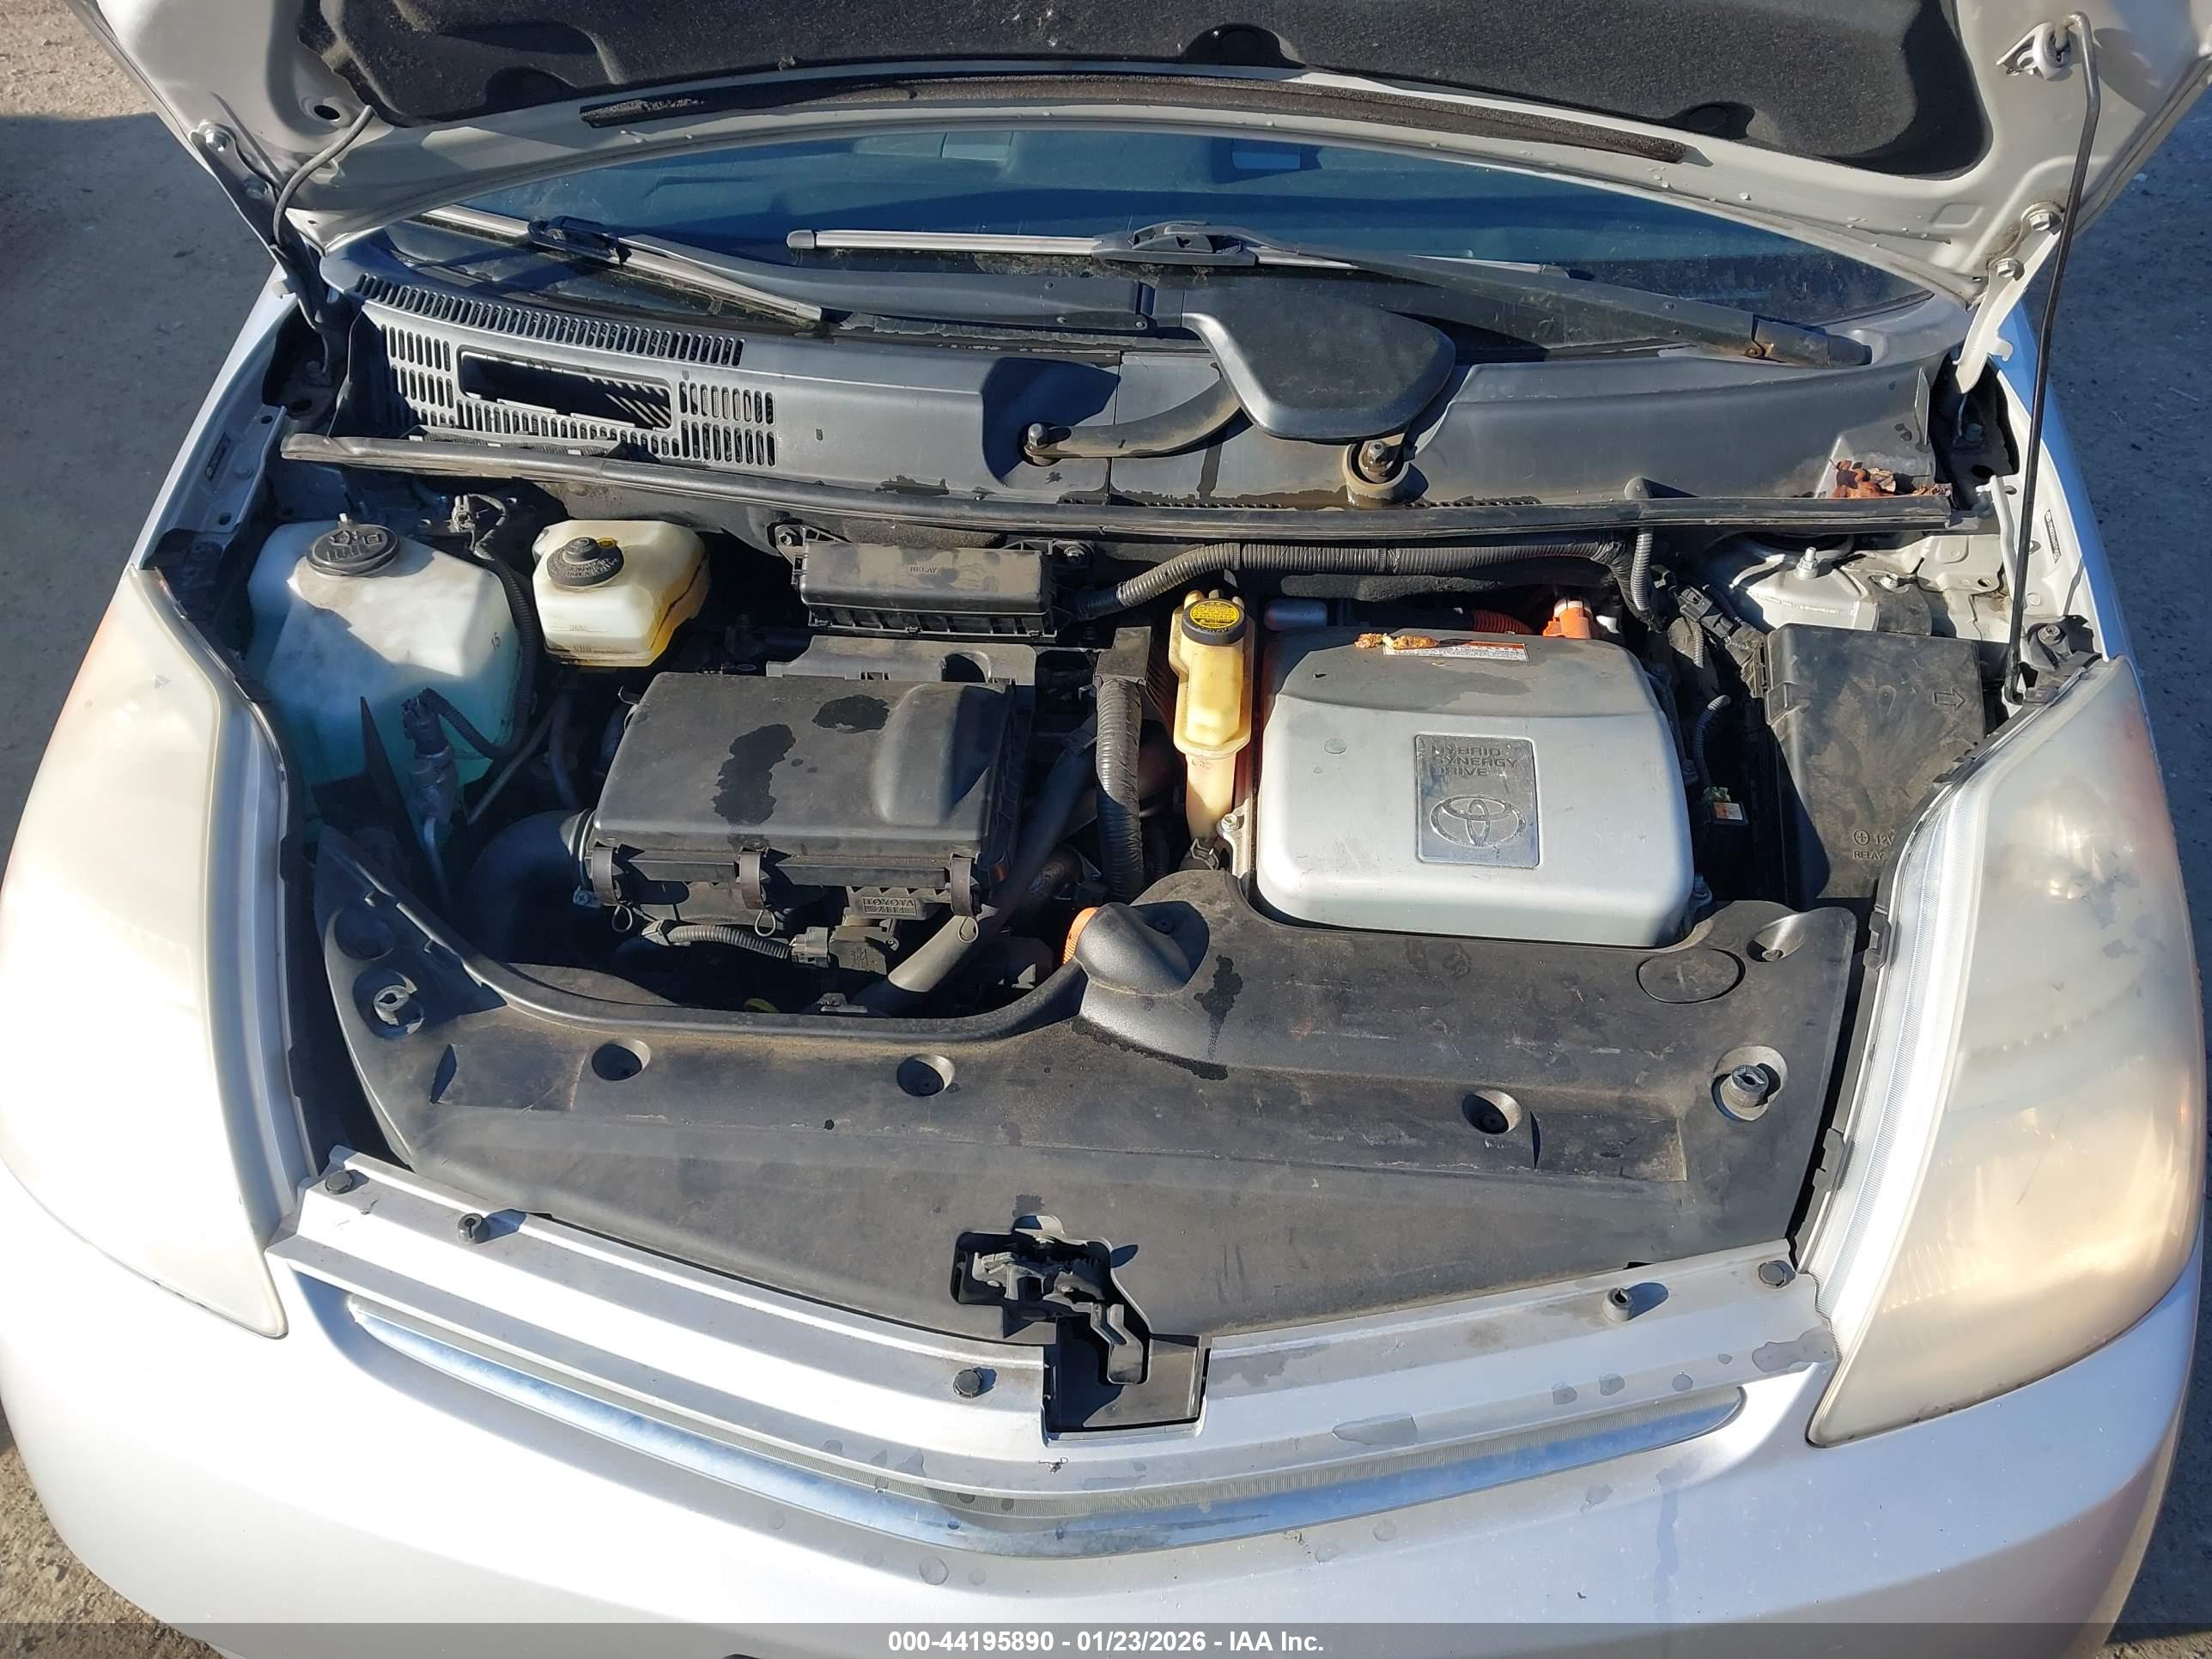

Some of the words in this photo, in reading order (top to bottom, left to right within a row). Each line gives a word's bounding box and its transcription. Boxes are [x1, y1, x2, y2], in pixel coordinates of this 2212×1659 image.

[1431, 744, 1502, 757] HYBRID
[1433, 757, 1518, 769] SYNERGY
[1433, 767, 1489, 777] DRIVE
[1874, 833, 1895, 846] 12V
[1852, 850, 1885, 860] RELAY
